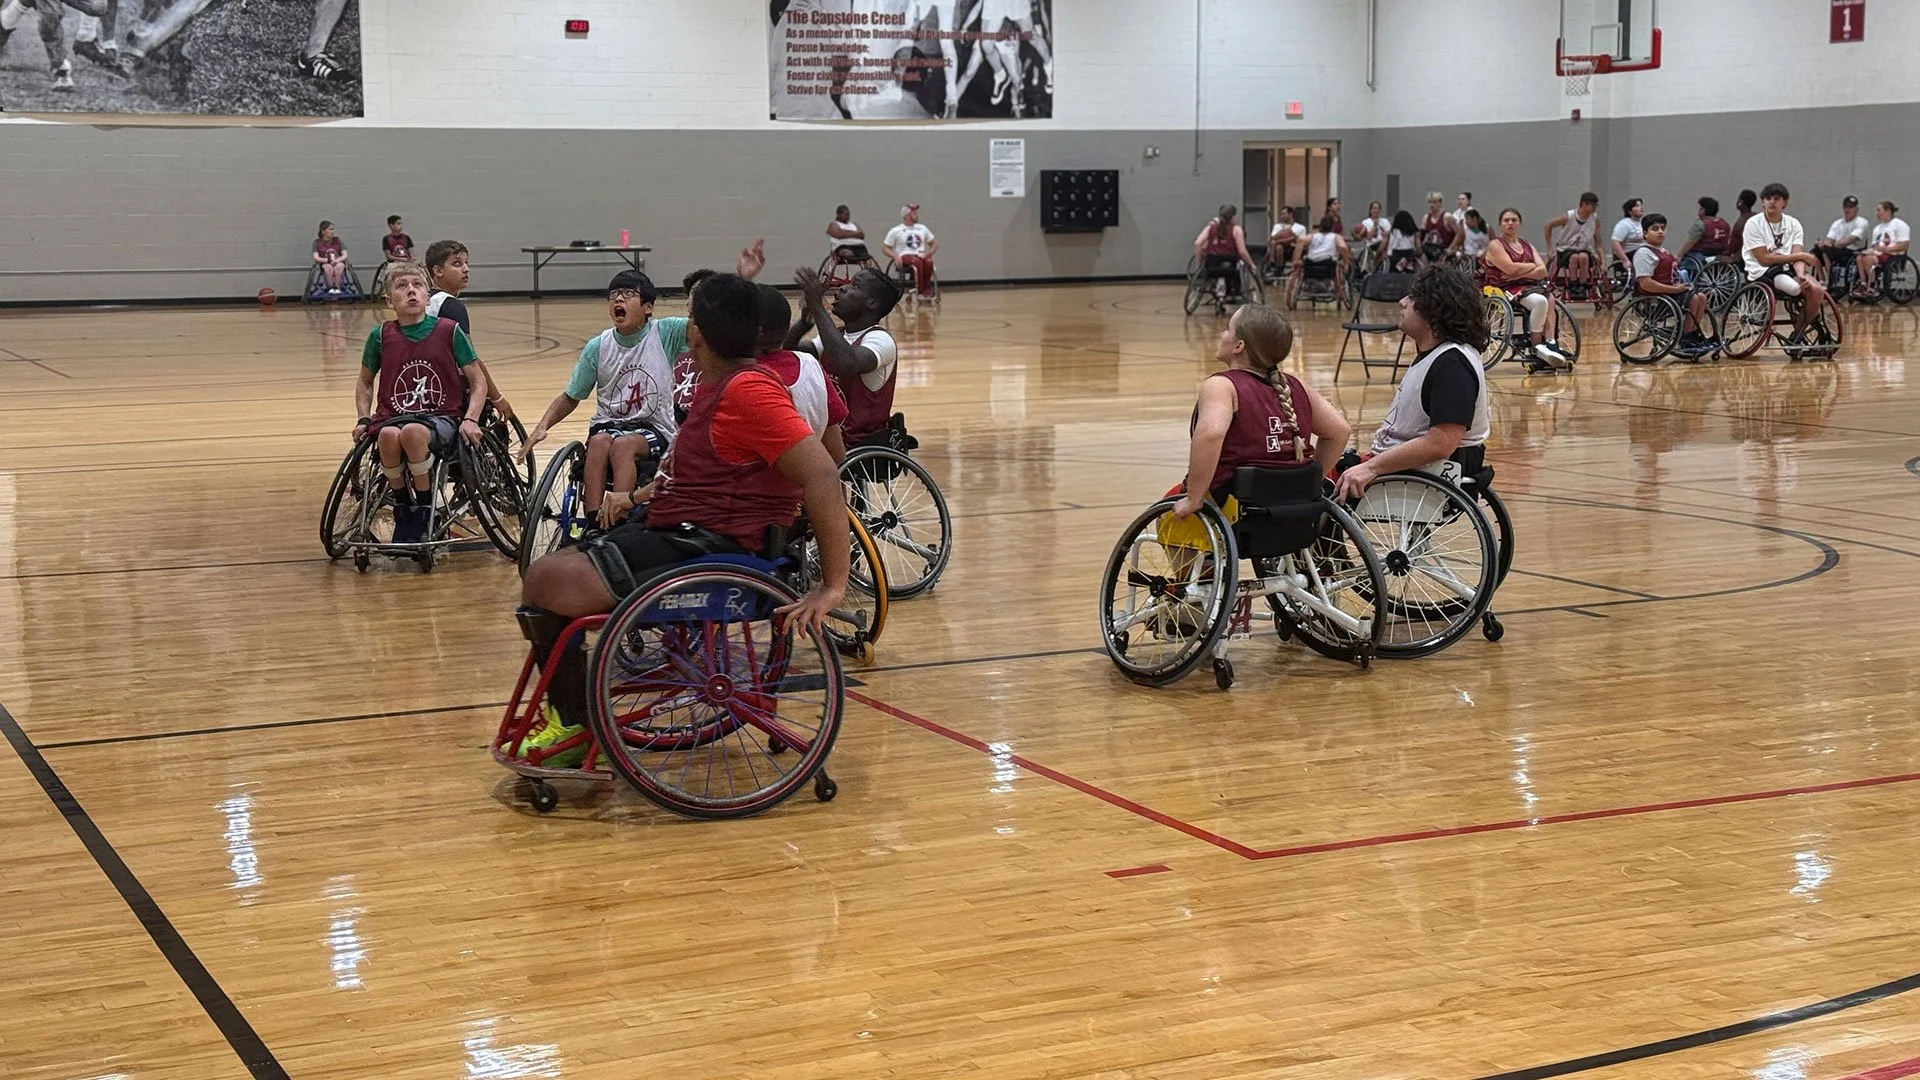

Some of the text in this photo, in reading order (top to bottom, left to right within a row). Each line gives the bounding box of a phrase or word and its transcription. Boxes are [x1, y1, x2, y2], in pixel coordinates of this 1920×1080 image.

[786, 10, 905, 26] The Capstone Creed
[1843, 7, 1851, 32] 1
[786, 28, 798, 39] As
[799, 30, 804, 39] a
[806, 28, 843, 39] member
[845, 29, 853, 39] of
[855, 29, 871, 39] The
[873, 29, 914, 40] University
[786, 42, 870, 54] Pursue knowledge;
[786, 56, 801, 67] Act
[803, 57, 822, 67] with
[787, 70, 815, 81] Foster
[787, 85, 813, 95] Strive
[815, 85, 828, 95] for
[402, 376, 430, 407] A
[617, 381, 644, 416] A
